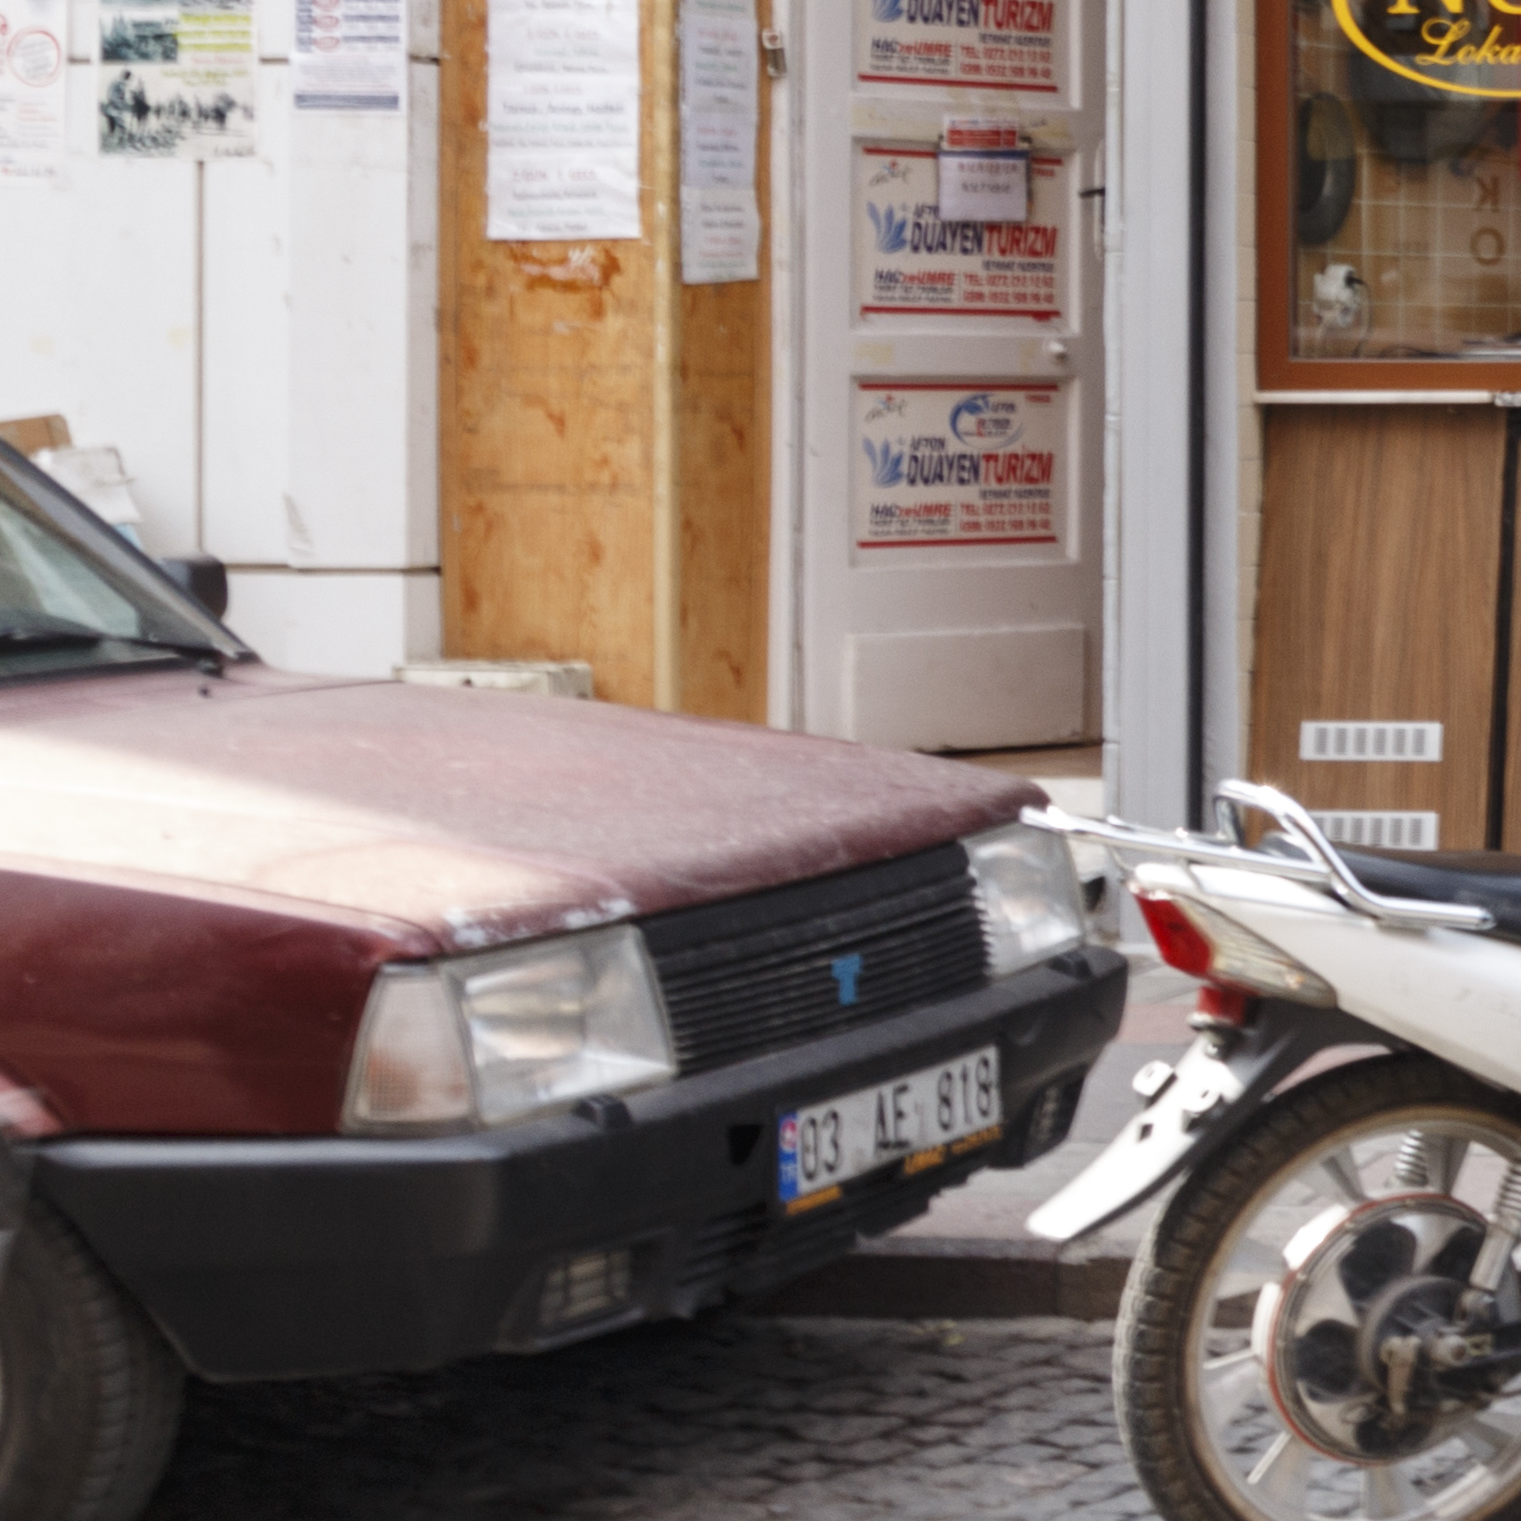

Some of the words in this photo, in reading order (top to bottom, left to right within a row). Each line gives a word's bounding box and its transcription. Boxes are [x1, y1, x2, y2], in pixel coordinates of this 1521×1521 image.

[910, 221, 984, 256] DUAYEN
[906, 453, 981, 488] DUAYEN
[982, 444, 1055, 486] TURİZM
[799, 1108, 841, 1182] 03
[875, 1083, 911, 1151] AE
[936, 1055, 994, 1132] 818
